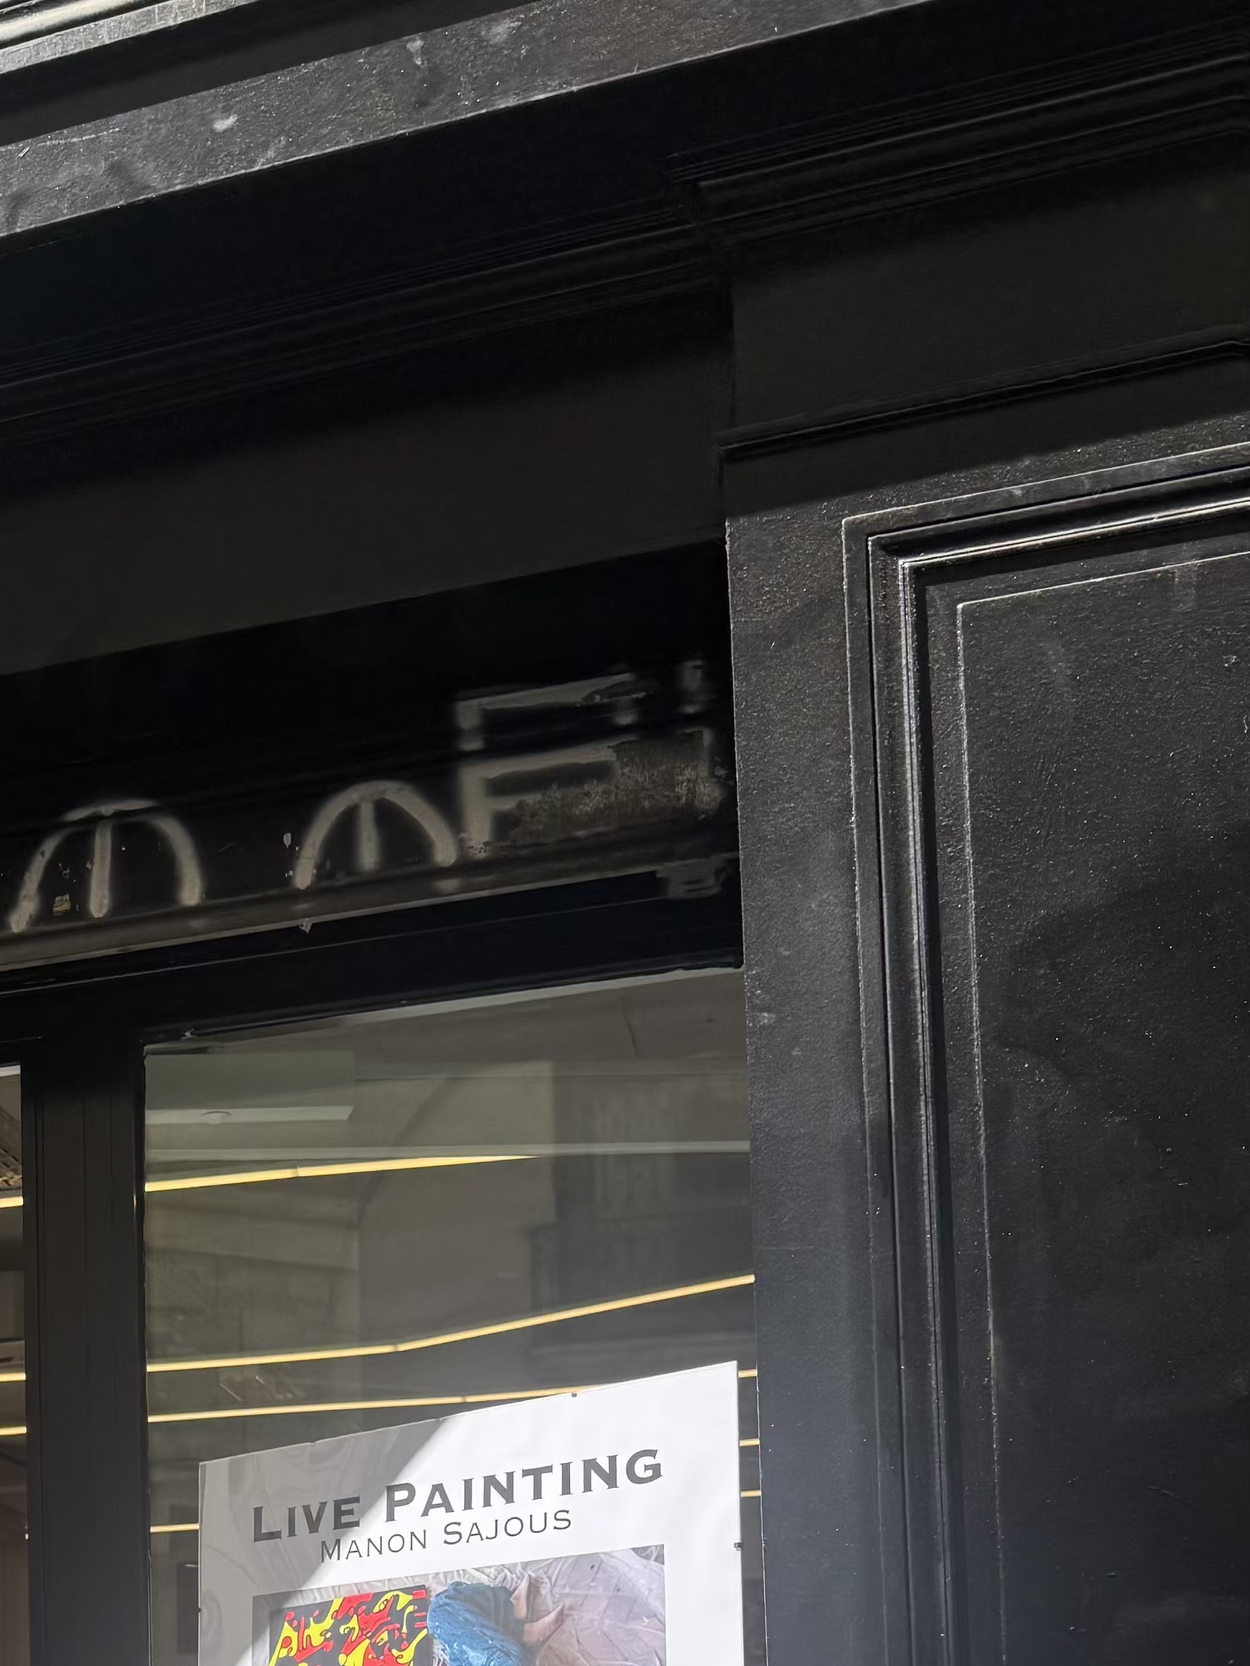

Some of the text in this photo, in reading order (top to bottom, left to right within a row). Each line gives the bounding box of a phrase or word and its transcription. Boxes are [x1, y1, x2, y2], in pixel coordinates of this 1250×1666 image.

[253, 1448, 664, 1543] LIVE PAINTING
[321, 1509, 572, 1564] MANON SAJOUS
